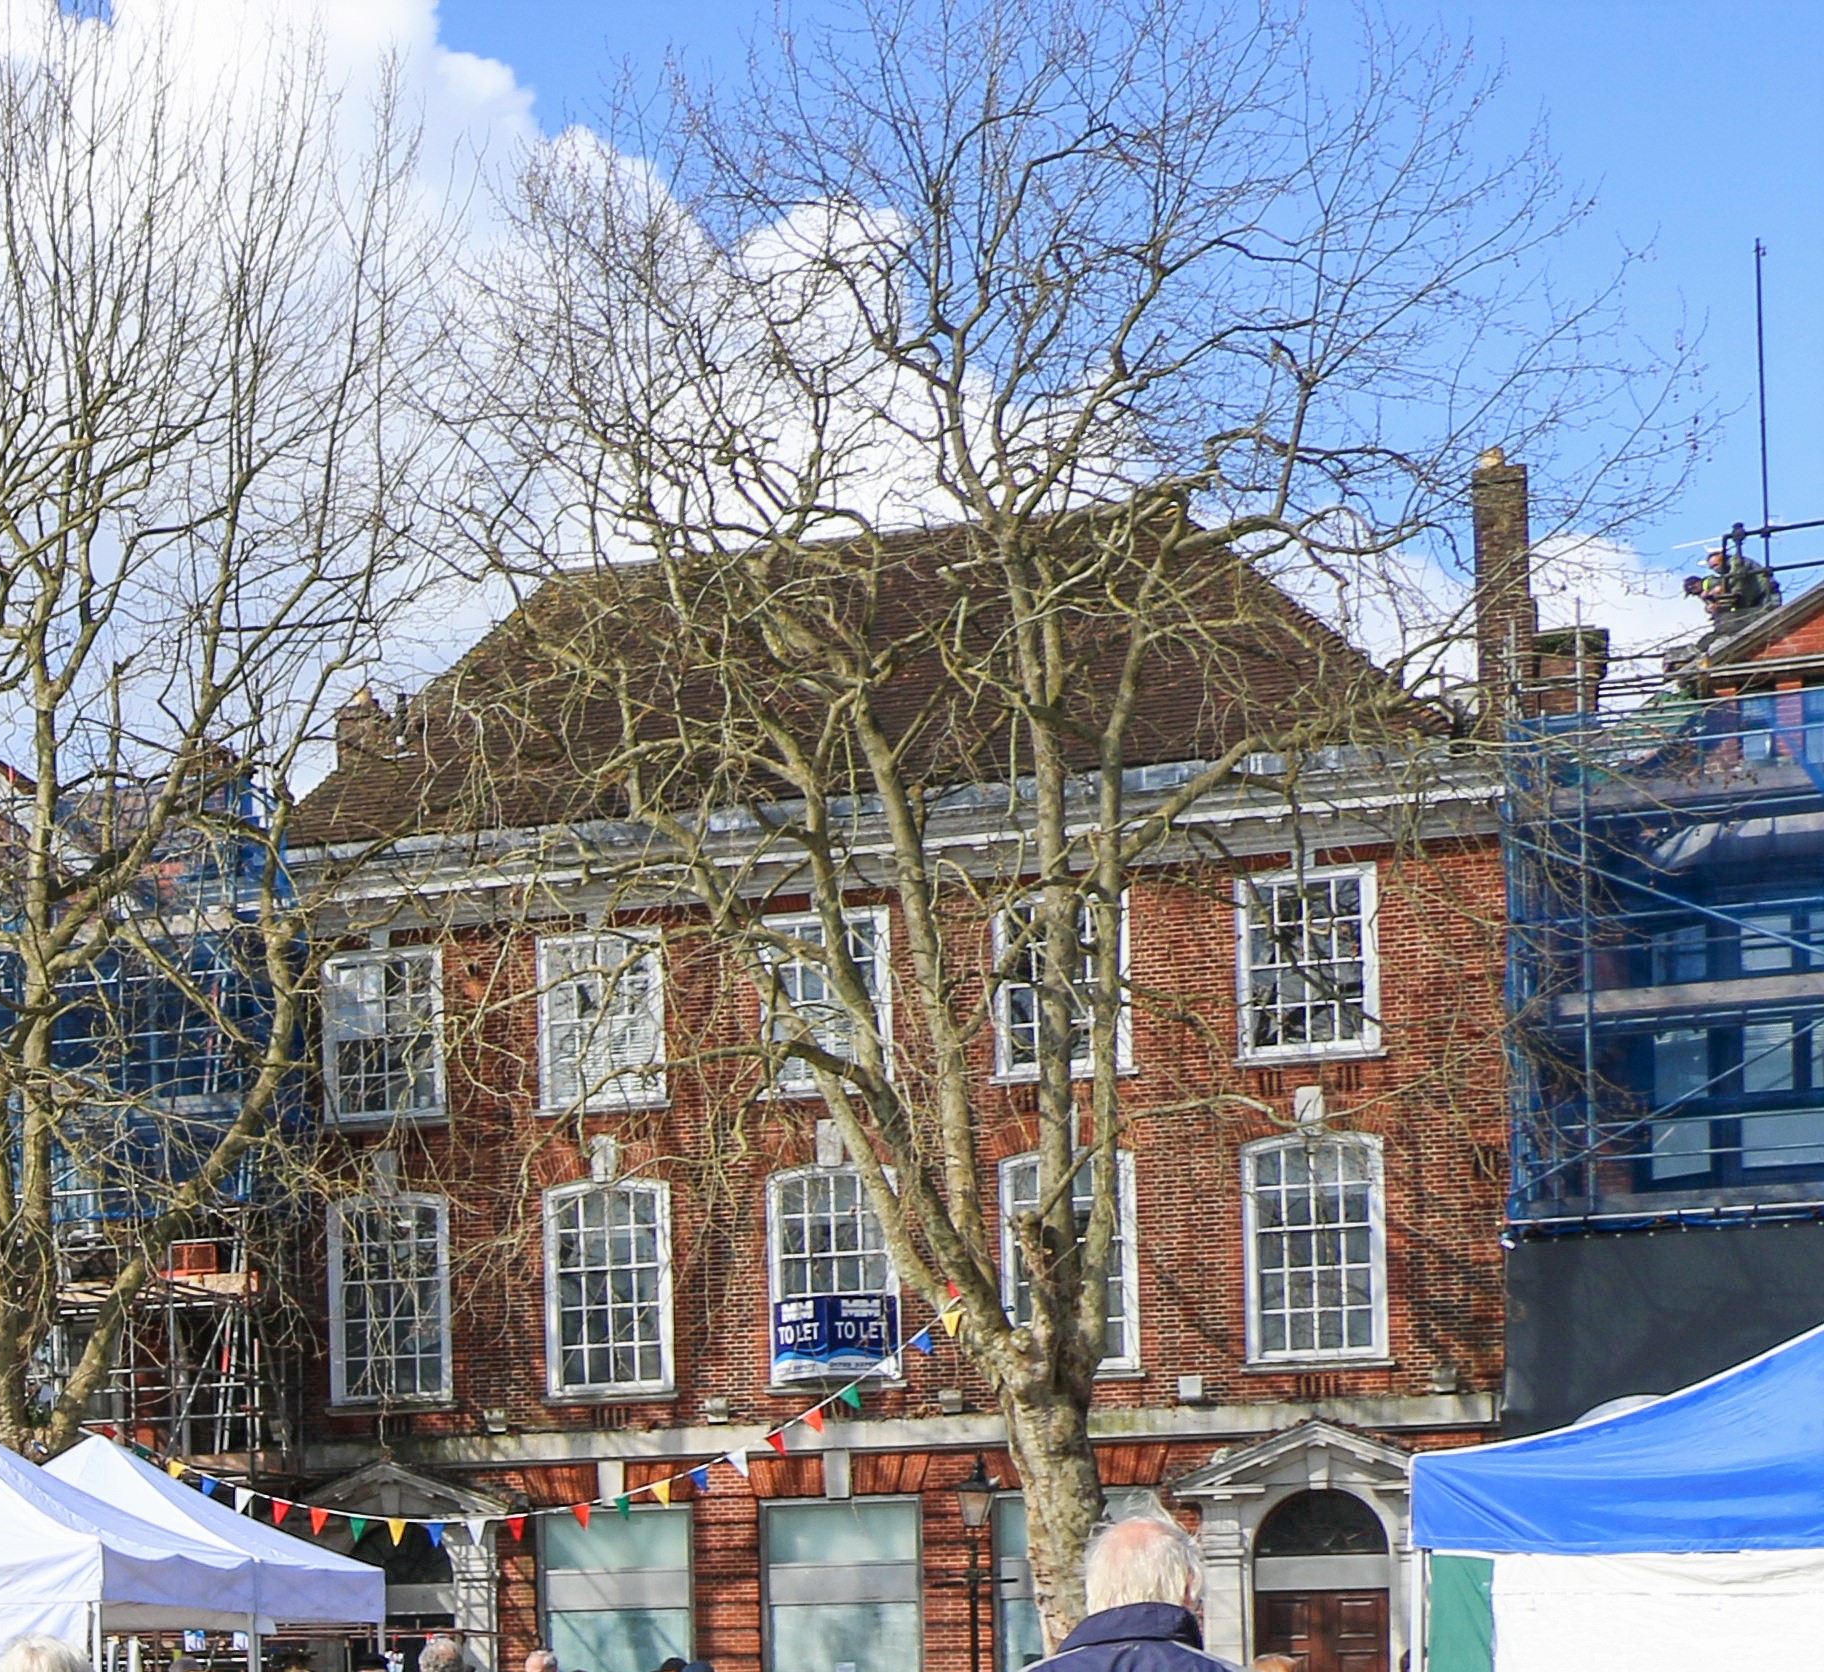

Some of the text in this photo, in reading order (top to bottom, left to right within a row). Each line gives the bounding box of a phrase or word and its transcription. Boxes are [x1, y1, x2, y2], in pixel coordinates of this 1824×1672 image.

[777, 1322, 820, 1345] TO LET
[834, 1321, 888, 1339] TO LET
